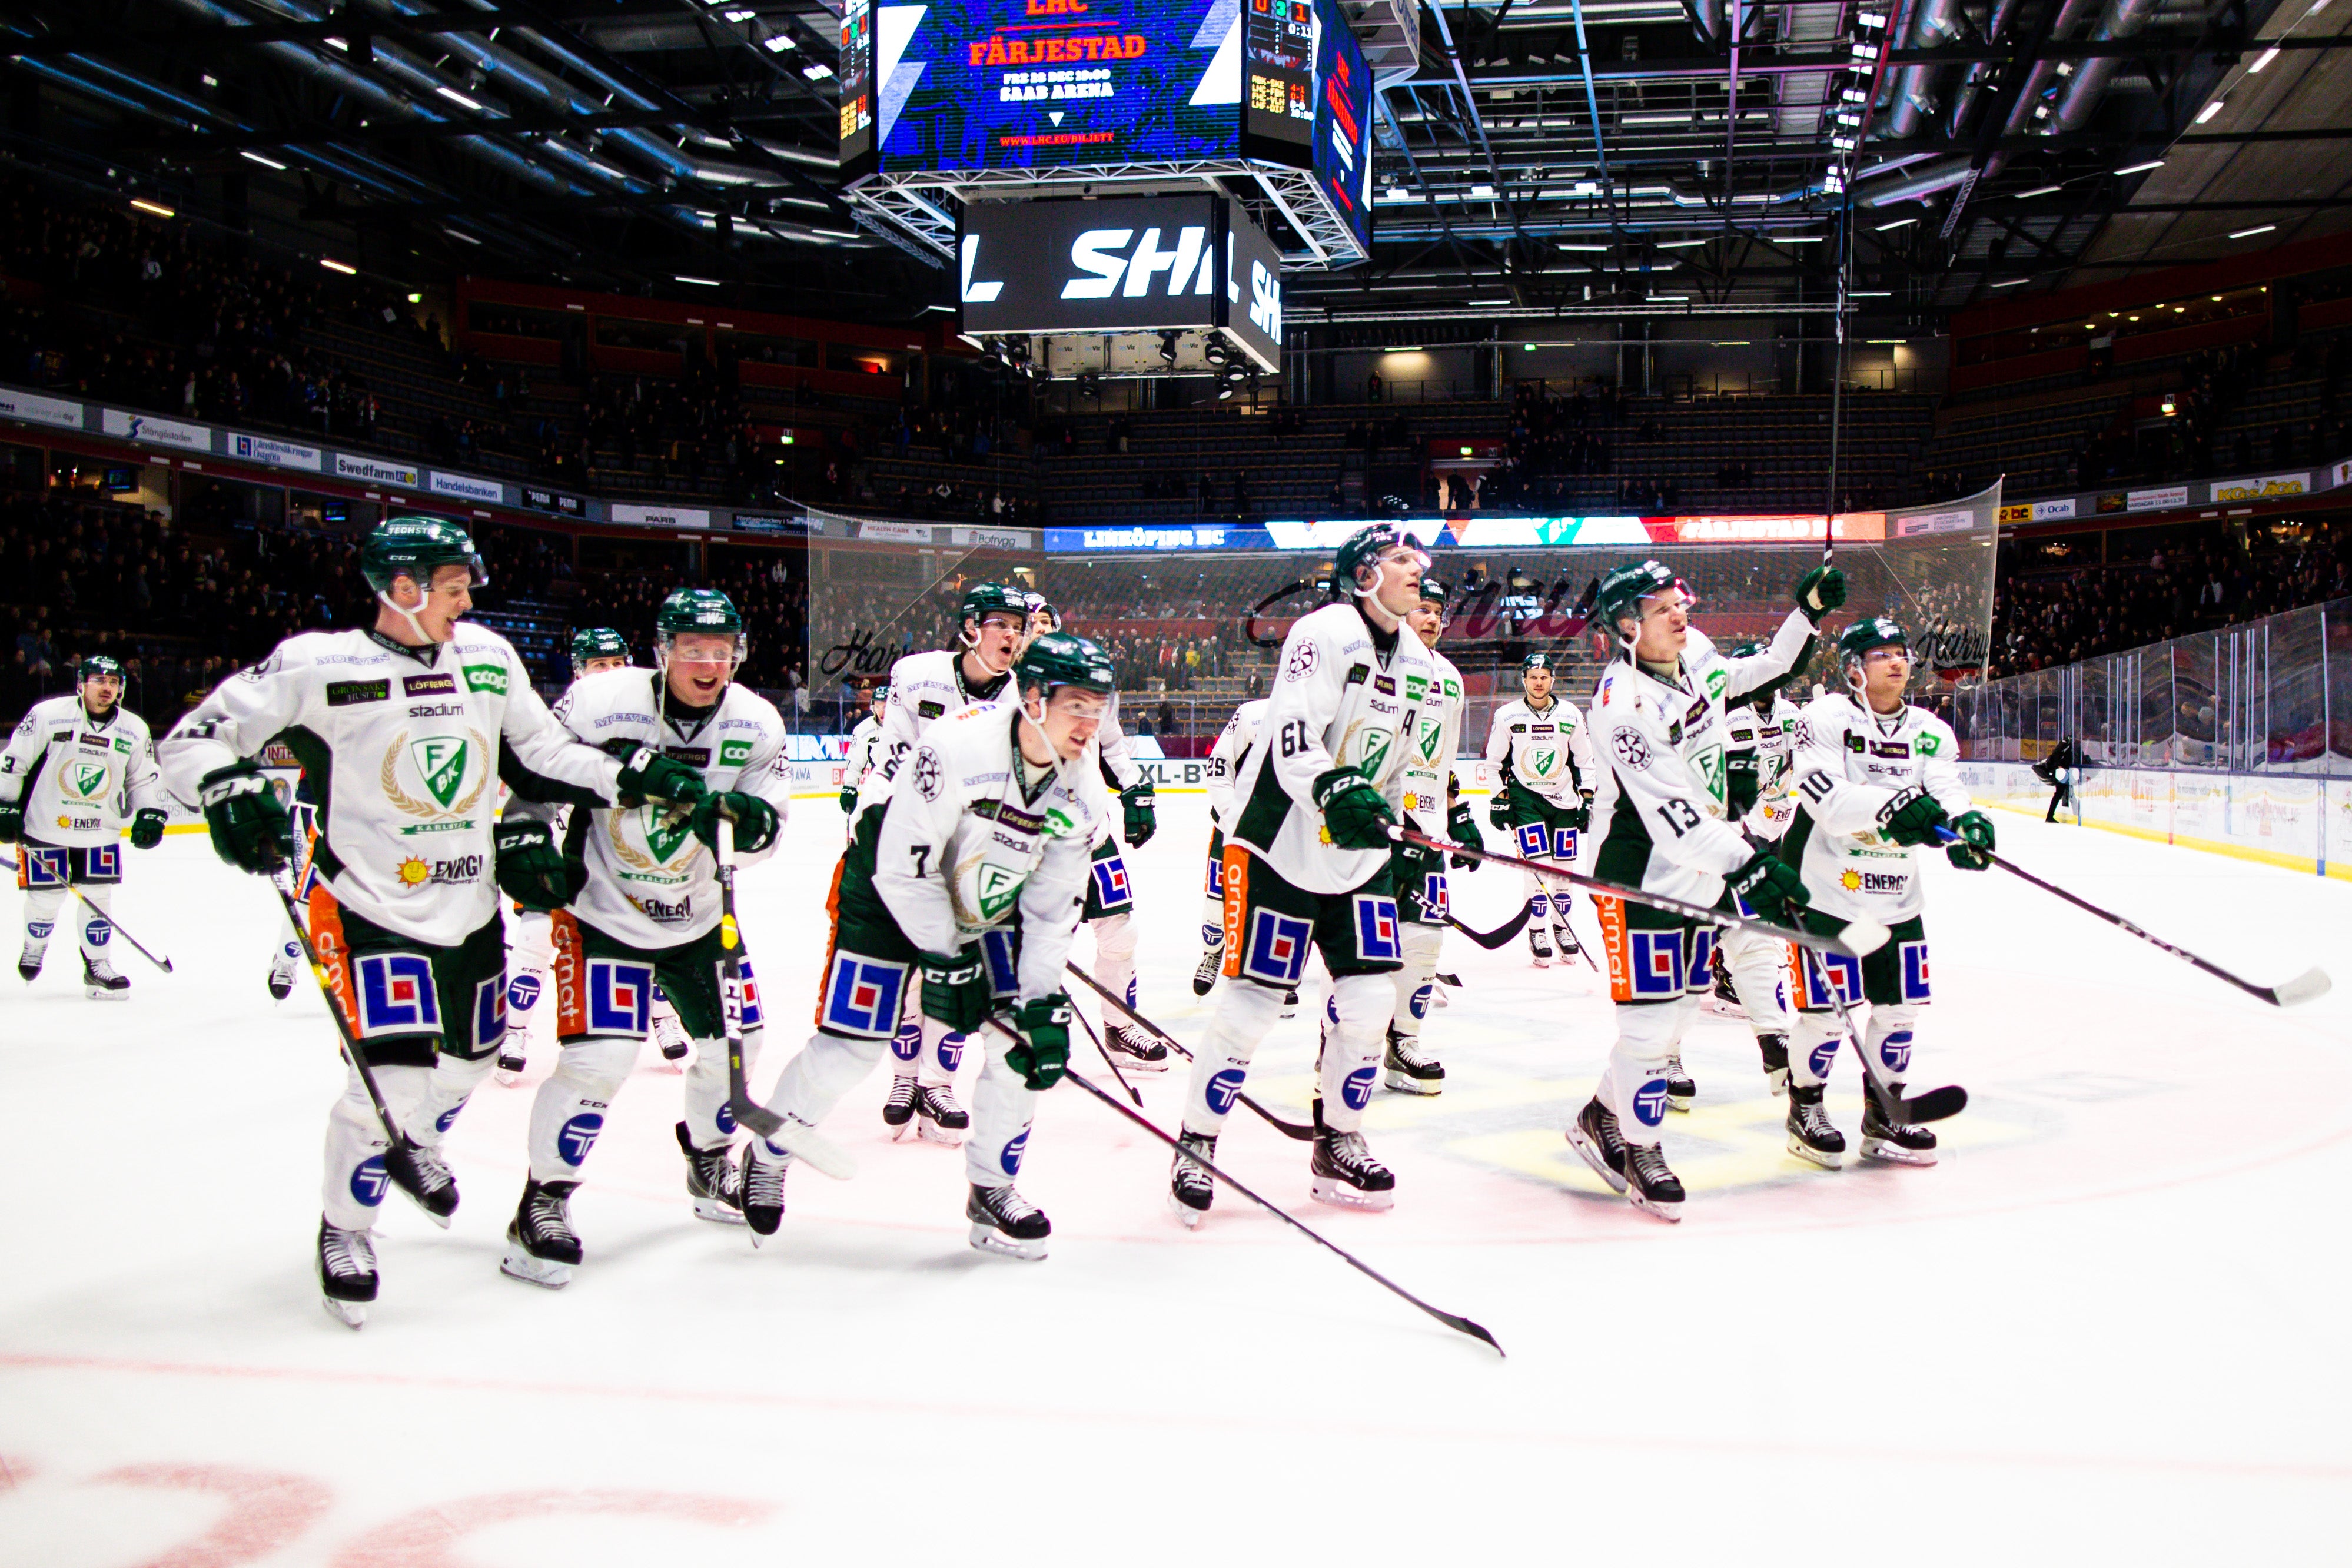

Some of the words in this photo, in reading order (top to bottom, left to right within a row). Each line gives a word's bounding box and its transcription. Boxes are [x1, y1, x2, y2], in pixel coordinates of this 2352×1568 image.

[1275, 0, 1287, 17] 3
[1295, 4, 1307, 22] 1
[969, 35, 1147, 66] FÄRJESTAD
[999, 85, 1049, 102] SAAB
[1051, 82, 1114, 99] ARENA
[1249, 259, 1282, 346] SH
[436, 478, 497, 499] Handelsbanken
[2260, 480, 2303, 496] ÄGG
[2047, 504, 2069, 514] Ocab
[316, 653, 391, 666] MOELVEN
[409, 703, 465, 718] stadium
[1401, 709, 1416, 737] A
[1281, 719, 1310, 758] 61
[1366, 732, 1381, 756] F
[425, 744, 445, 774] F
[1868, 763, 1913, 776] stadium
[436, 762, 460, 794] BK
[1799, 771, 1834, 805] 10
[1657, 799, 1702, 838] 13
[910, 845, 931, 878] 7
[986, 871, 1011, 895] F
[725, 978, 743, 1041] CCM
